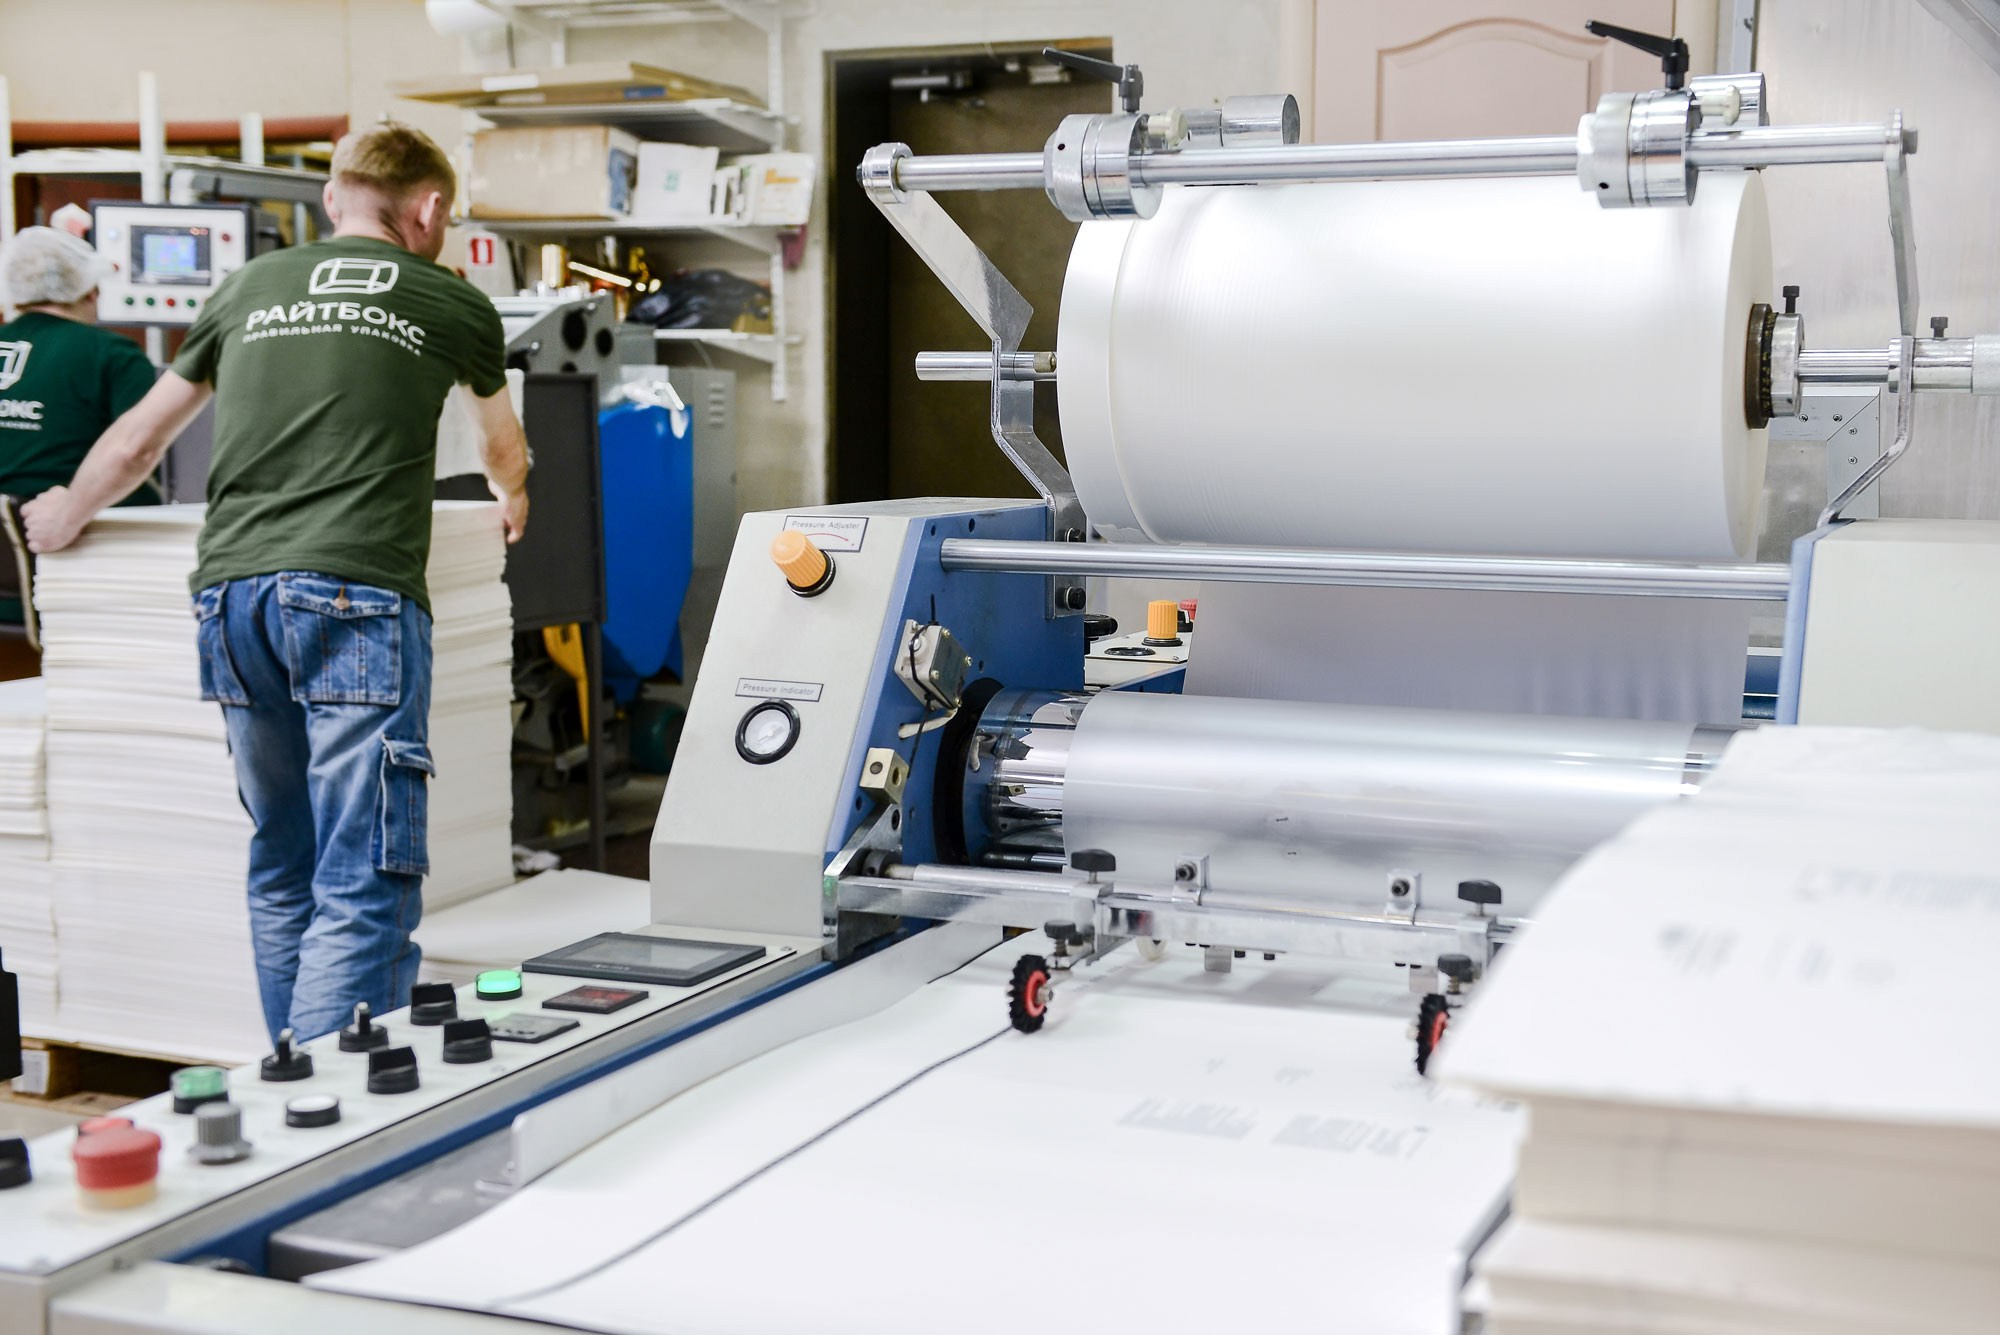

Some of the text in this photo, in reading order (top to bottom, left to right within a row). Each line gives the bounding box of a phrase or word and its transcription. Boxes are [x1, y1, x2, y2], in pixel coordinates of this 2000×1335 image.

[245, 300, 426, 345] РАЙТБОКС
[792, 520, 860, 530] Pressure Adjuster
[743, 684, 777, 693] Pressure
